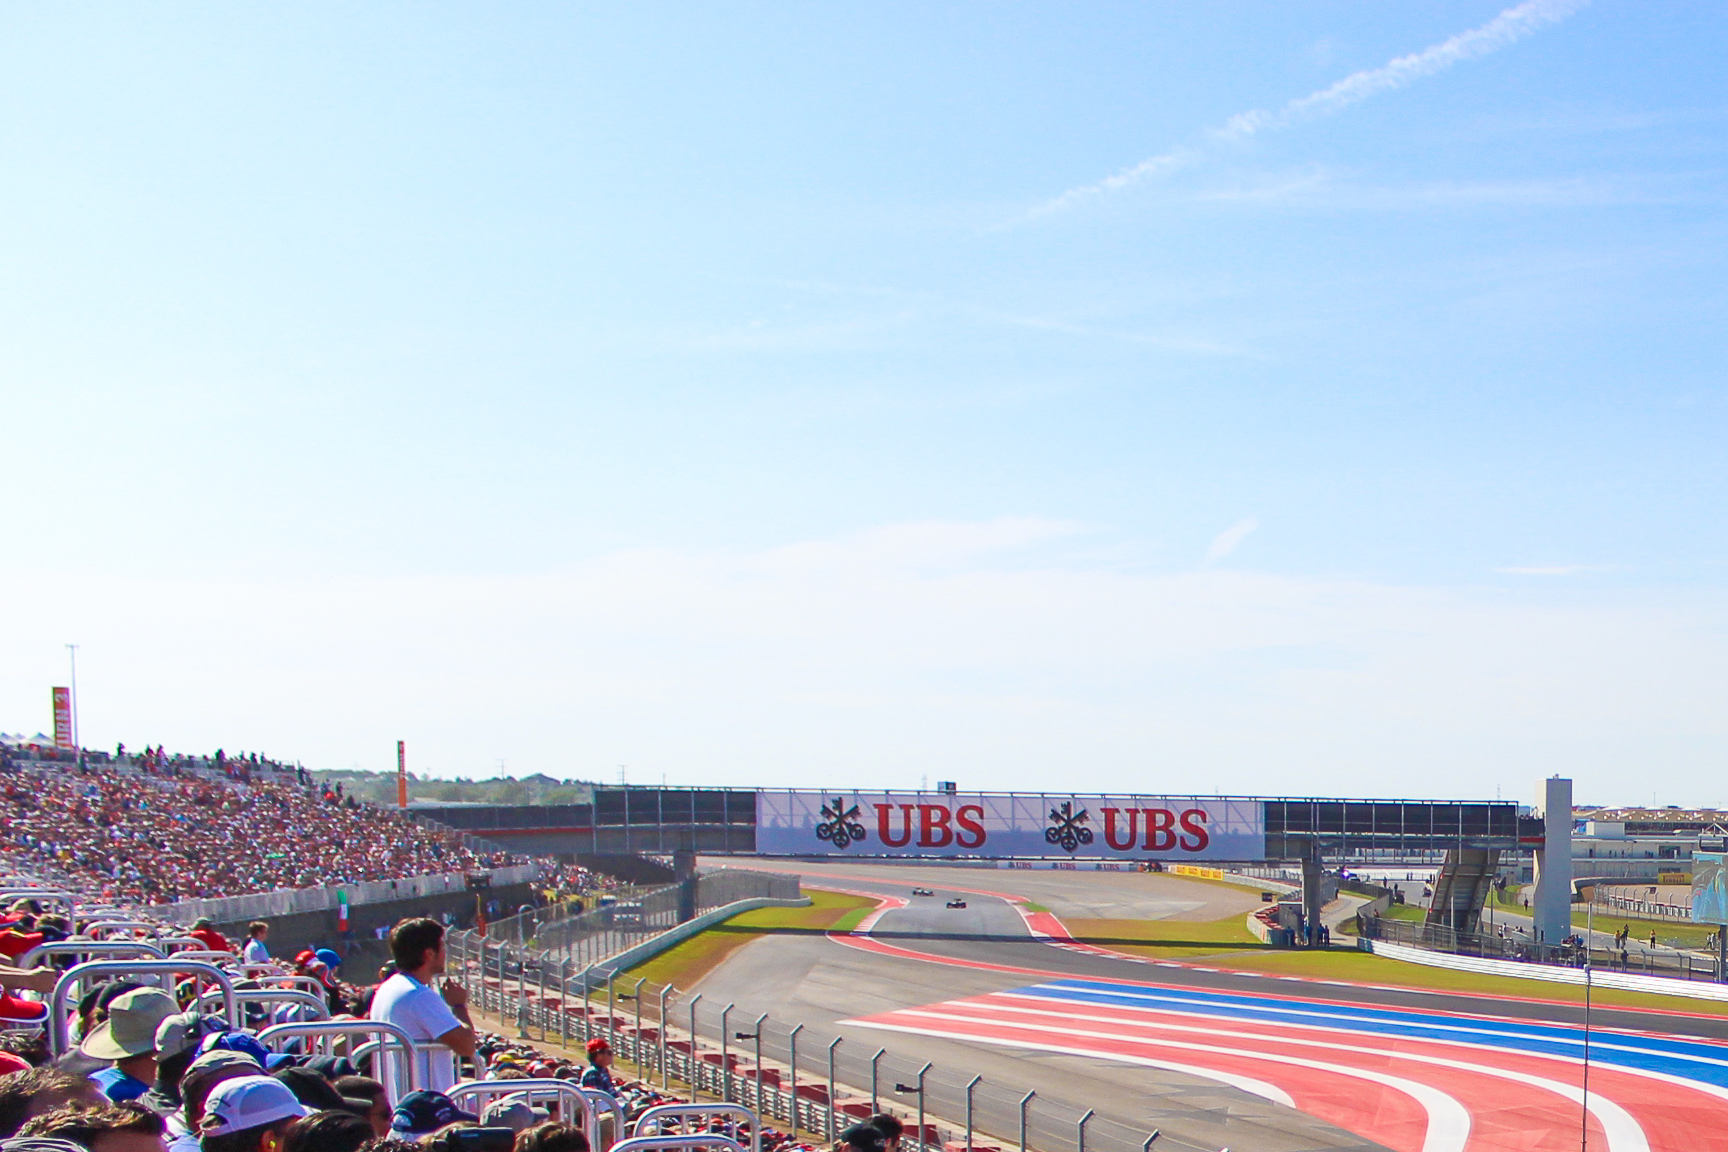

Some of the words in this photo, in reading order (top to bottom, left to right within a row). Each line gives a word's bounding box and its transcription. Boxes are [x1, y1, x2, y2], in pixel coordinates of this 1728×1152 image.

[873, 803, 987, 849] UBS
[1101, 808, 1210, 852] UBS
[1015, 861, 1033, 870] UBS
[1059, 862, 1076, 871] UBS
[1103, 863, 1120, 871] UBS
